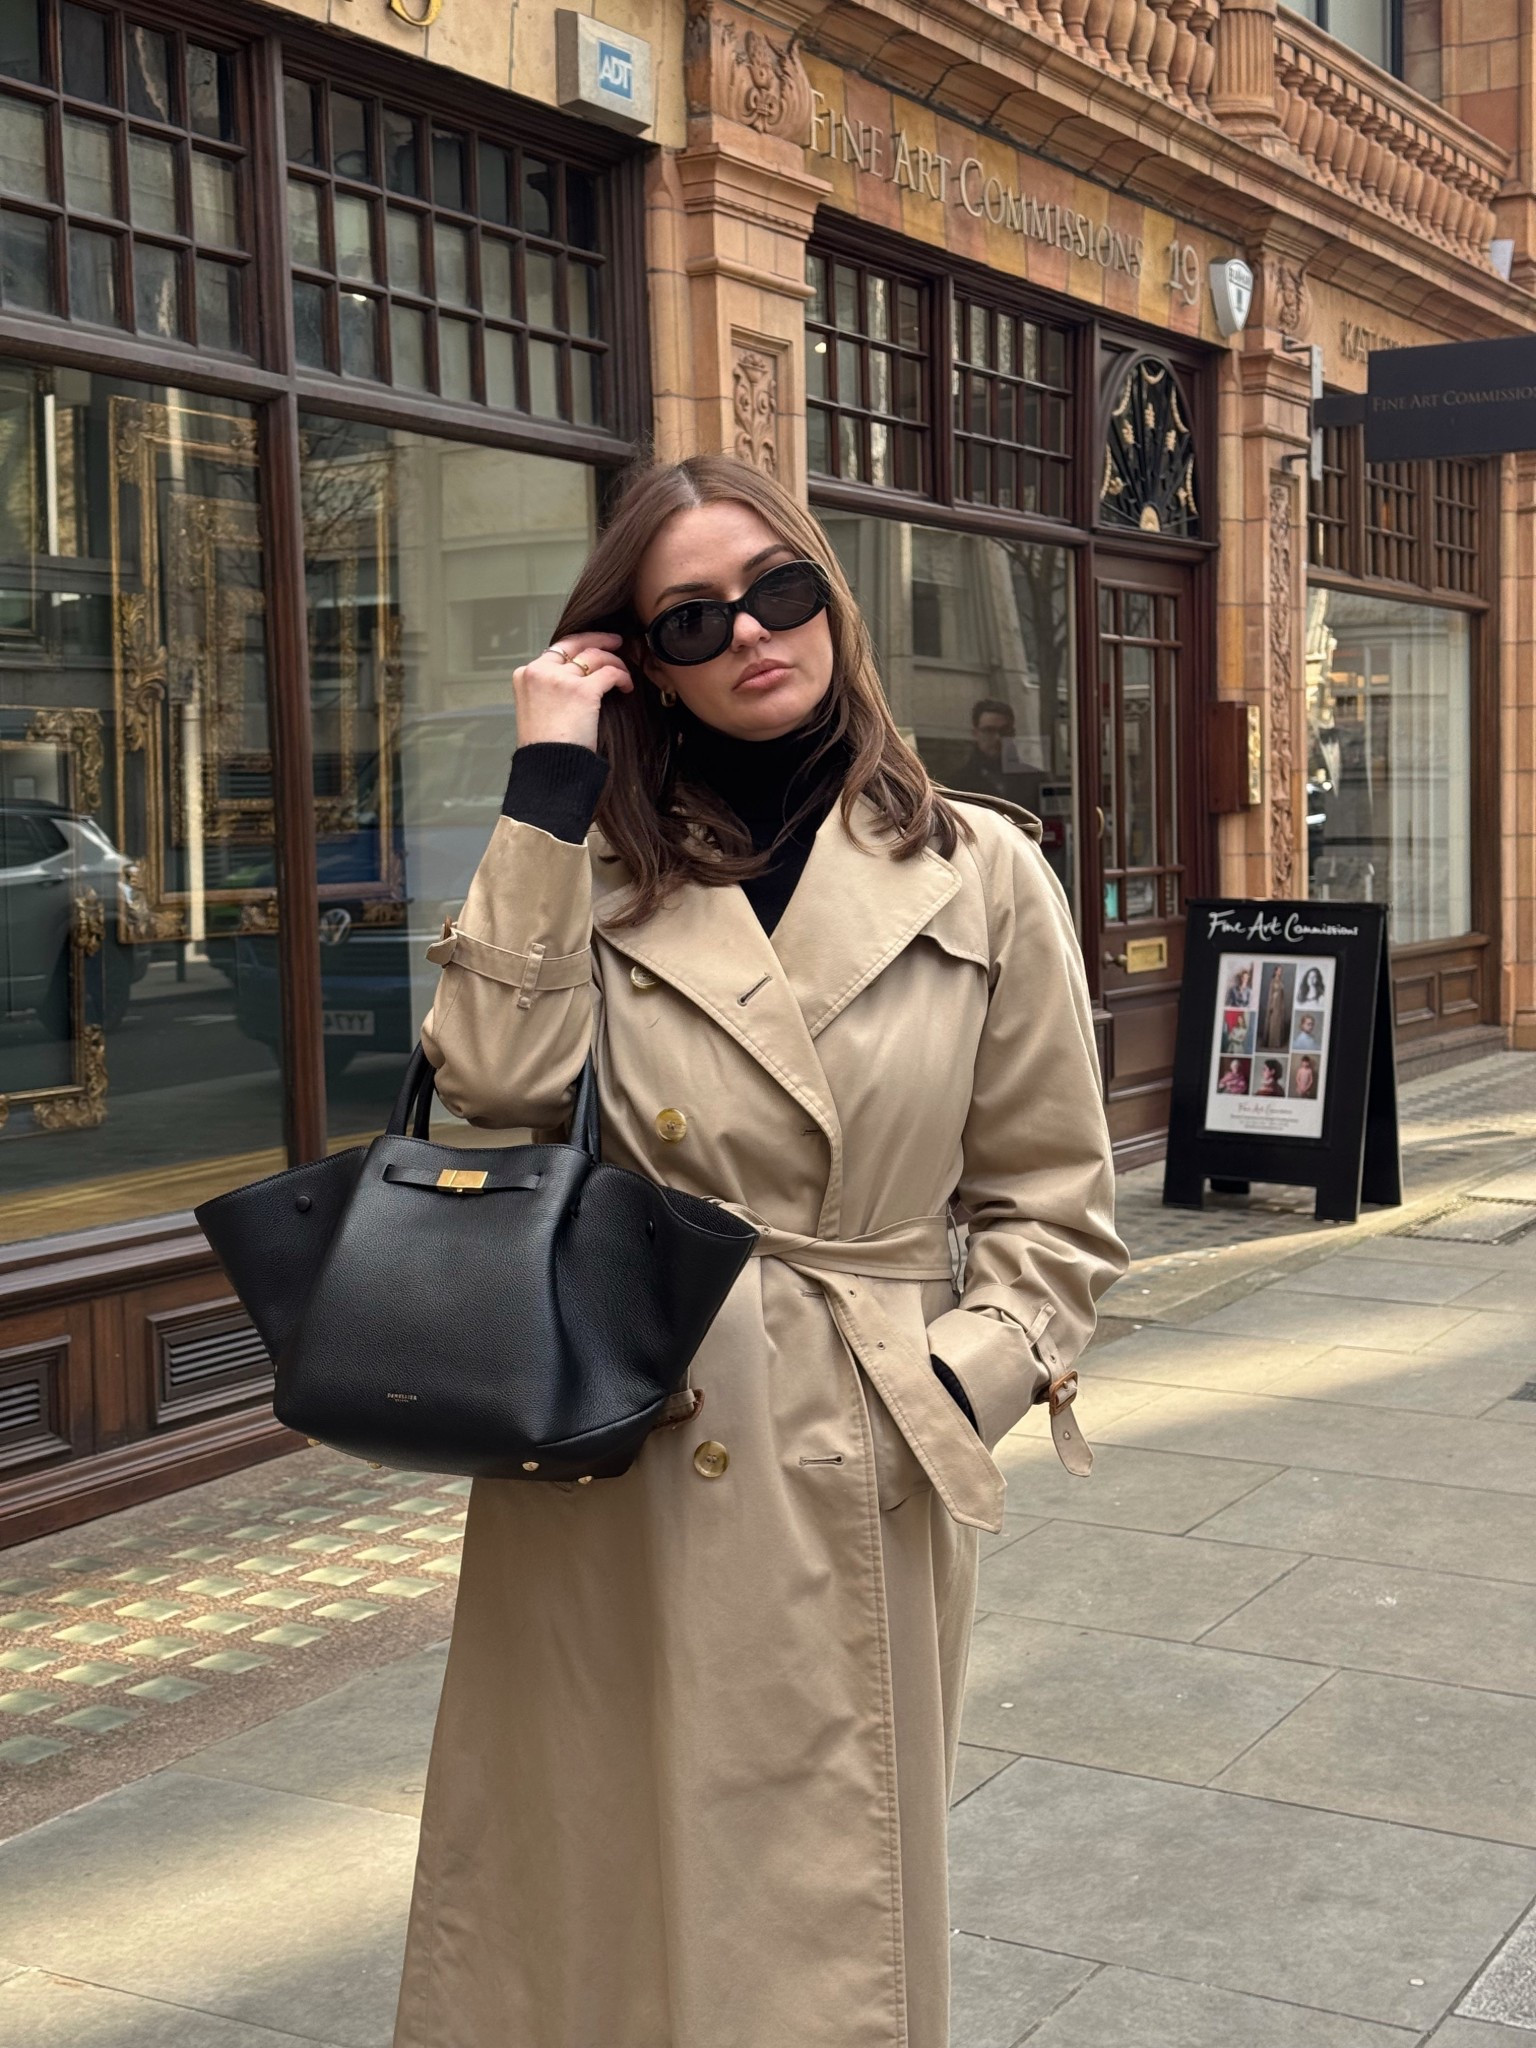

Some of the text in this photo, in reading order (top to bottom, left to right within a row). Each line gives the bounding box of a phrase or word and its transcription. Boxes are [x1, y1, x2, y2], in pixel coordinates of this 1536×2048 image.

[600, 54, 632, 90] ADT
[810, 88, 1200, 306] FINE ART COMMISSIONS 19
[1372, 395, 1408, 412] FINE
[1409, 394, 1440, 410] ART
[1207, 909, 1359, 943] Fine Art Commissions
